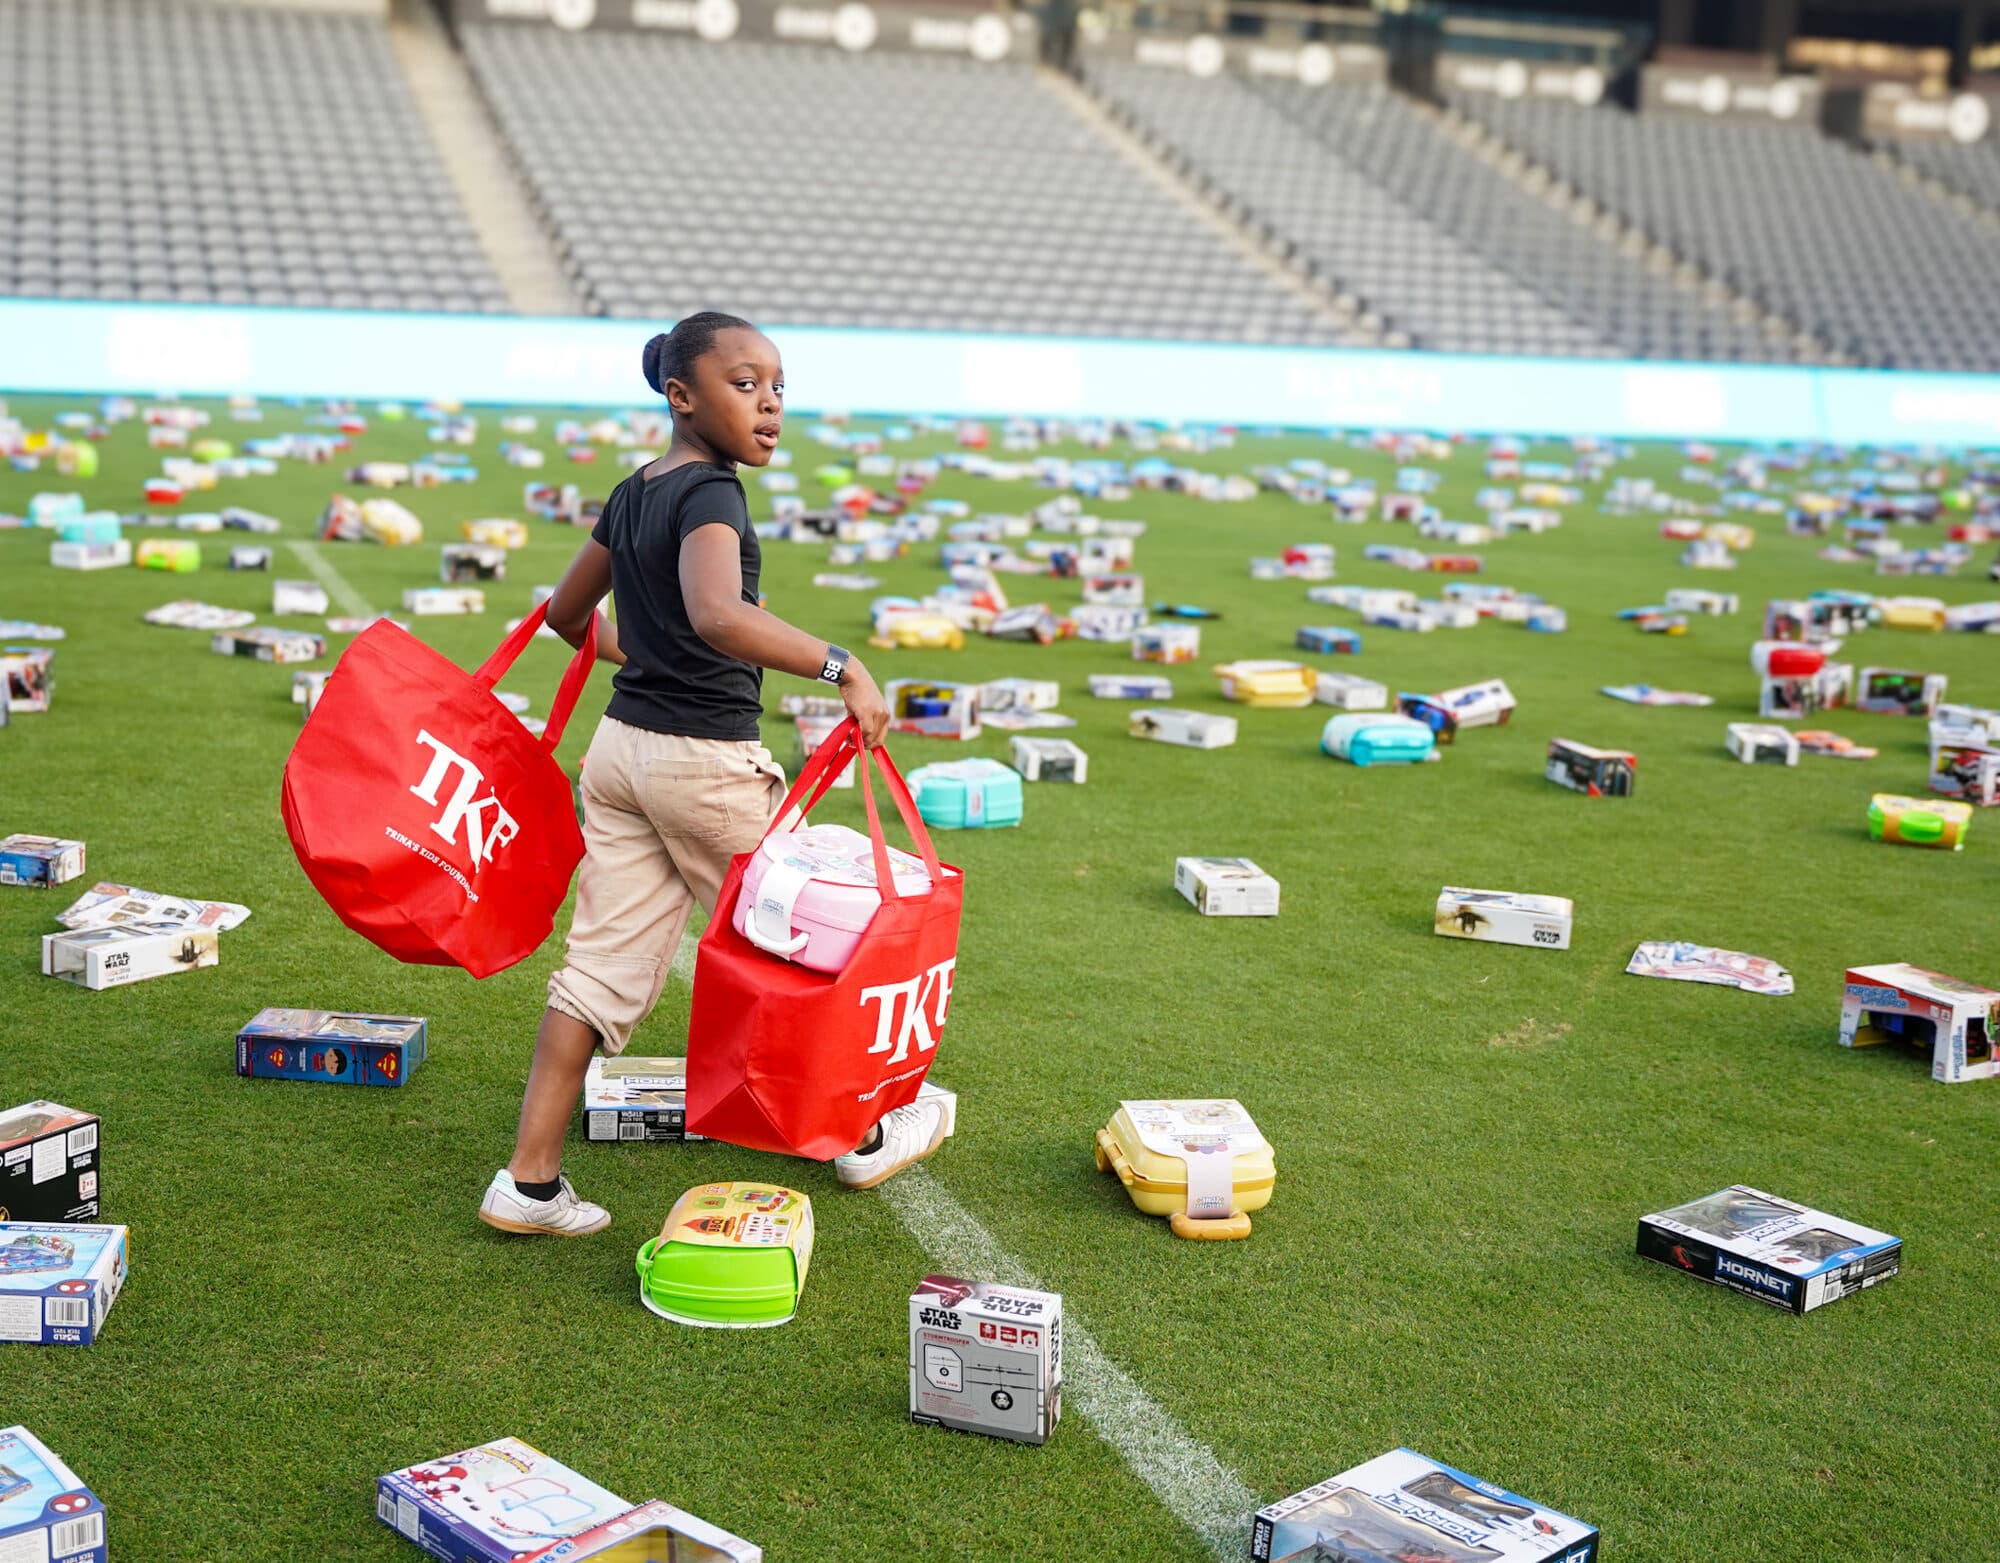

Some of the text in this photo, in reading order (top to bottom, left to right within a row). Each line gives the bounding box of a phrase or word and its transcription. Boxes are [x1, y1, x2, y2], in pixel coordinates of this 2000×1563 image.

[823, 660, 842, 680] SB
[409, 728, 520, 874] TKF
[385, 826, 420, 852] TRINA'S
[419, 847, 440, 864] KIDS
[104, 952, 130, 963] STAR
[104, 959, 129, 969] WARS
[1717, 1256, 1791, 1295] HORNET
[981, 1301, 1042, 1316] STAR
[982, 1296, 1043, 1310] WARS
[919, 1307, 961, 1321] STAR
[920, 1315, 962, 1330] WARS
[53, 1333, 81, 1341] WORLD
[923, 1331, 970, 1345] STORMTROOPER
[1375, 1493, 1489, 1544] HORNET
[1253, 1522, 1265, 1556] WORLD
[556, 1542, 573, 1555] GT
